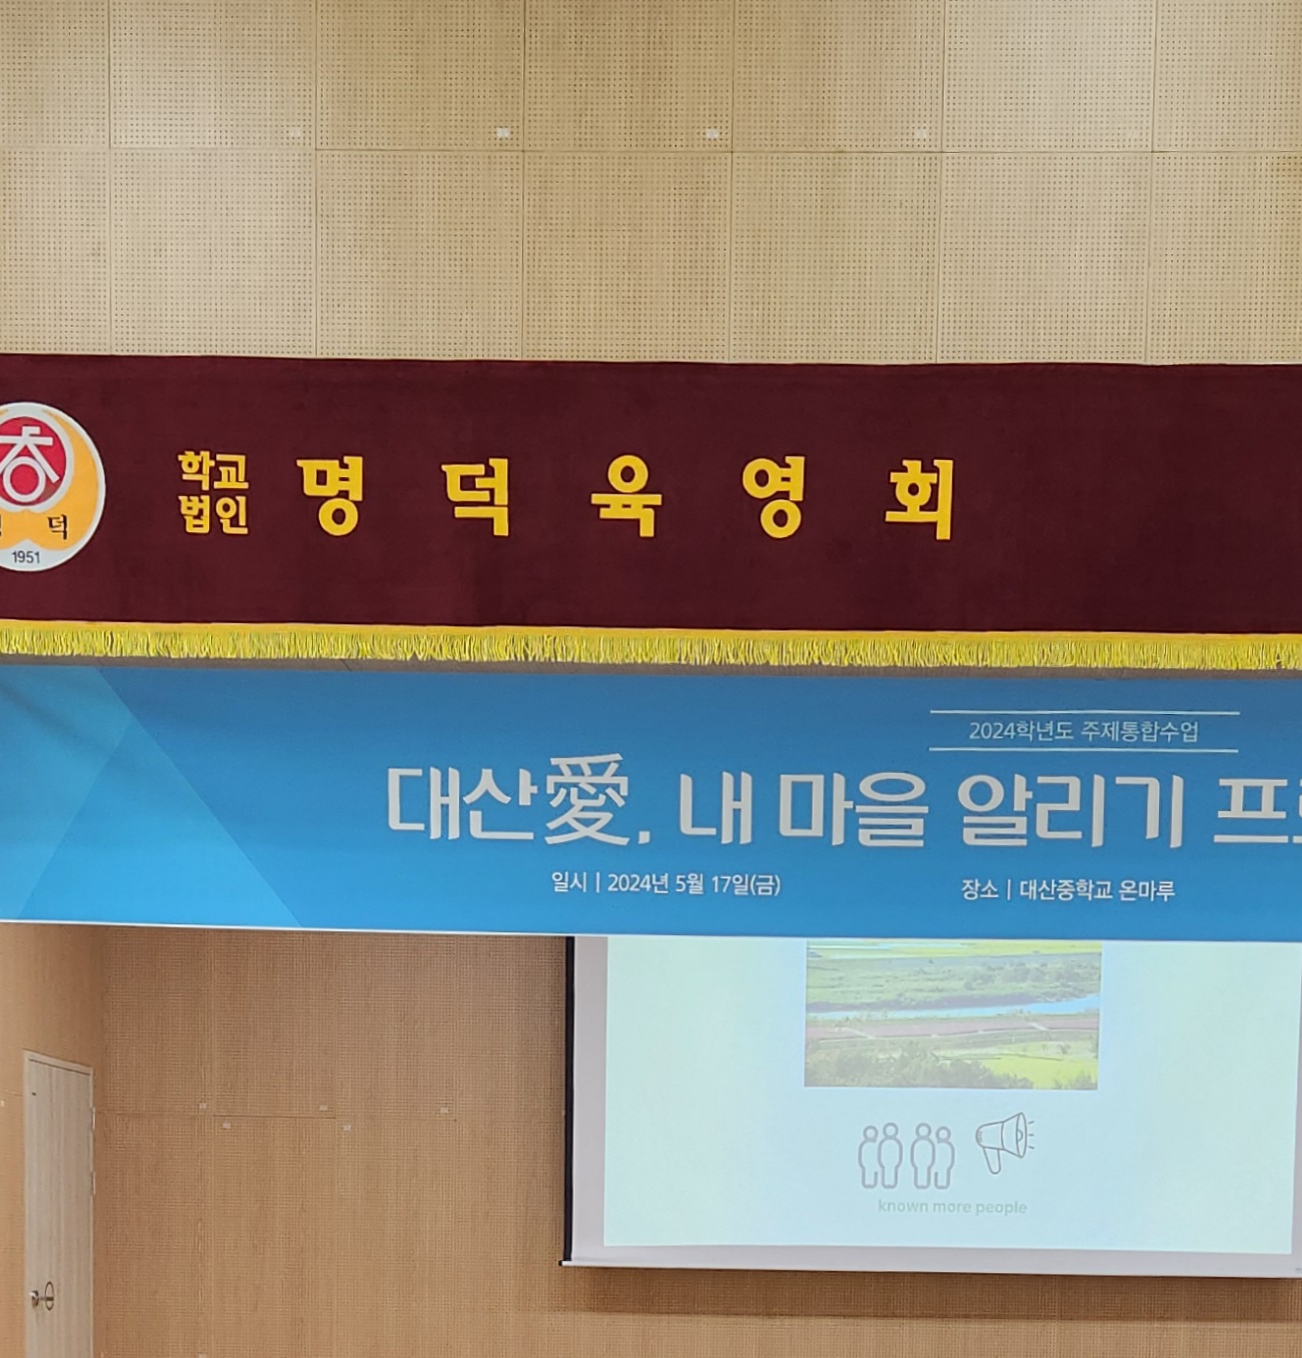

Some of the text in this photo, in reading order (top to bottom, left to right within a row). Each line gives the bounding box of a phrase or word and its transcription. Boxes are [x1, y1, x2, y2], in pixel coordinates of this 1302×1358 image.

[177, 450, 249, 491] 학교
[178, 494, 248, 535] 법인
[11, 550, 41, 564] 1951
[969, 720, 1199, 743] 2024학년도 주제통합수업
[387, 753, 651, 846] 대산愛,
[680, 771, 753, 845] 내
[779, 771, 930, 848] 마을
[957, 773, 1184, 849] 알리기
[551, 871, 782, 897] 일시 2024년 5월 17일(금)
[961, 878, 1176, 902] 장소 대산중학교 온마루
[878, 1200, 1028, 1216] known more people
